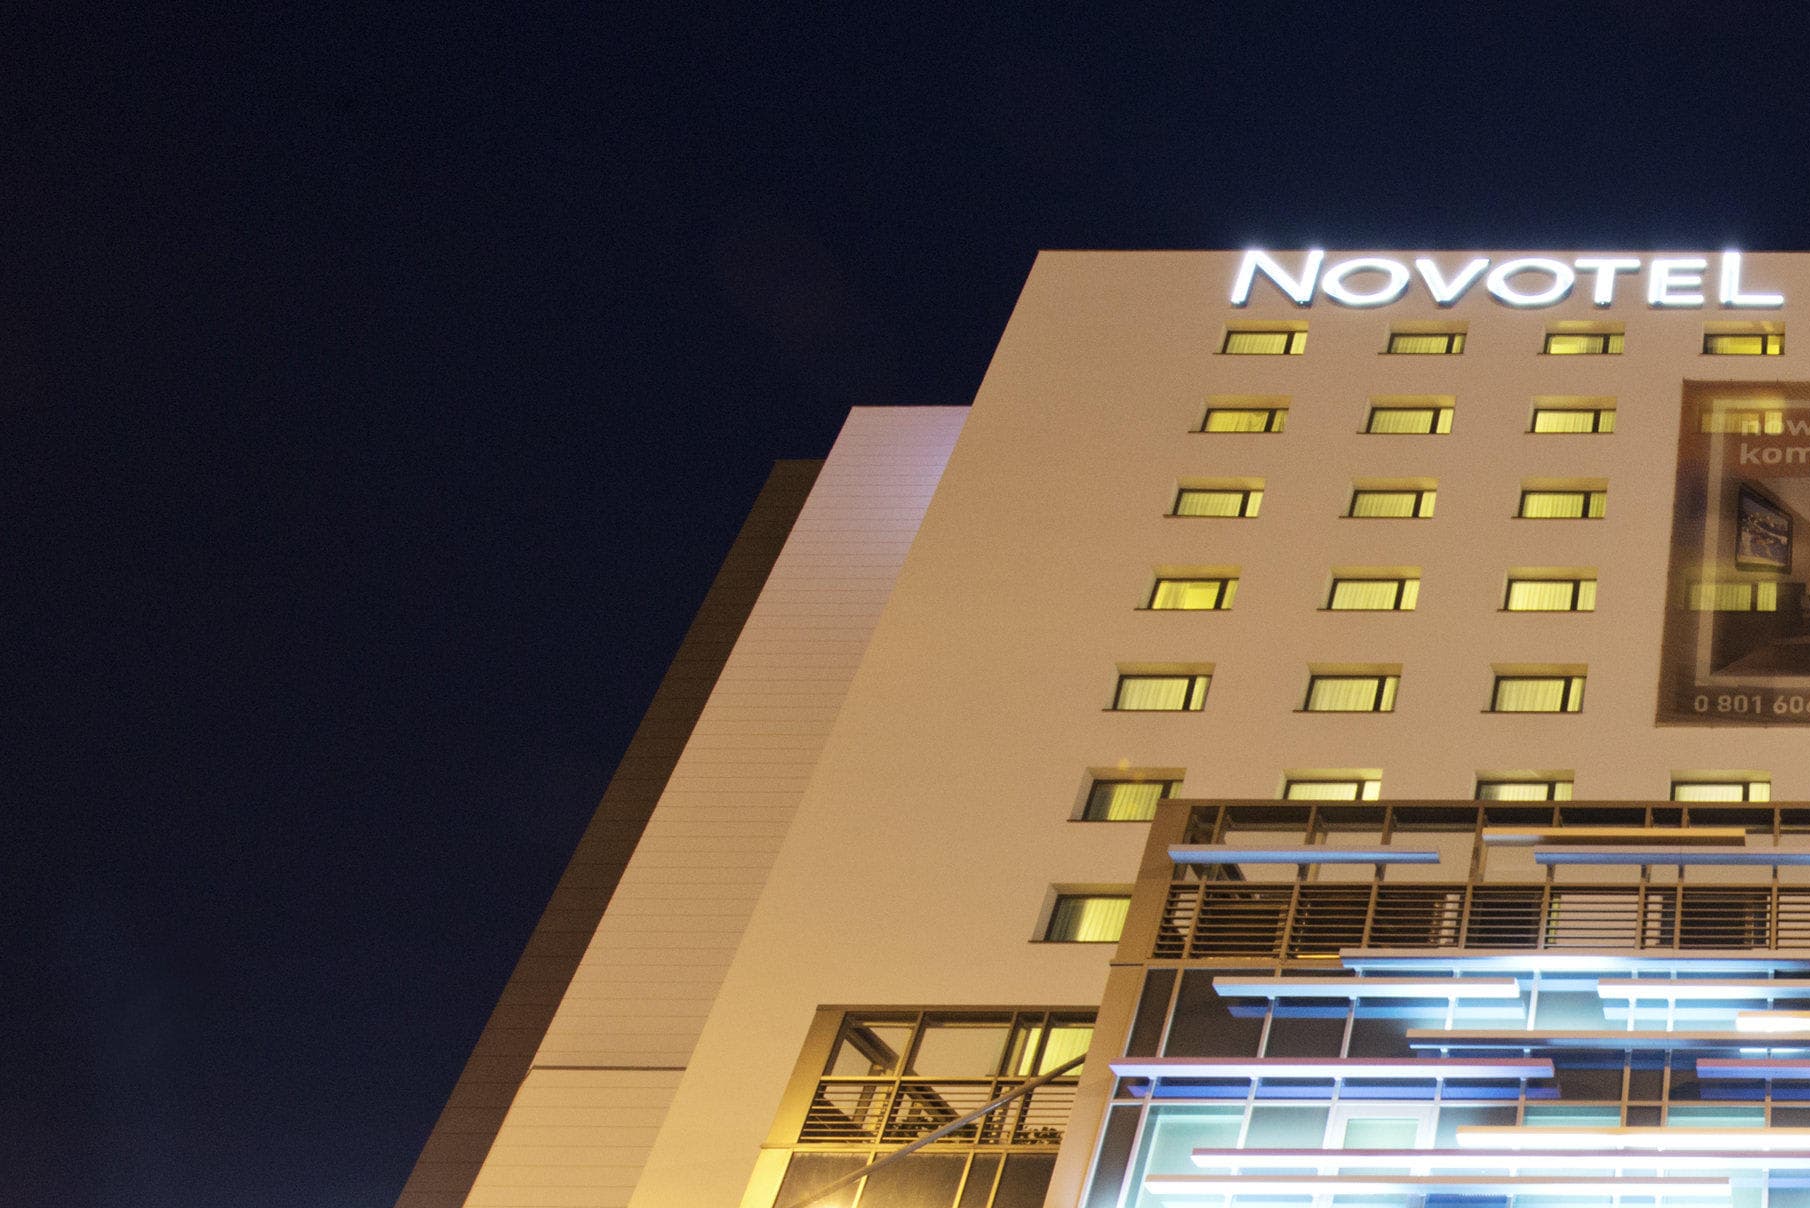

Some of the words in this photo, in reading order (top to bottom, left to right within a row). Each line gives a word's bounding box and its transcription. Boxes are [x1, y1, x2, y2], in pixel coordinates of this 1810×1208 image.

[1230, 249, 1785, 307] NOVOTEL
[1694, 695, 1709, 713] 0
[1716, 695, 1762, 714] 801
